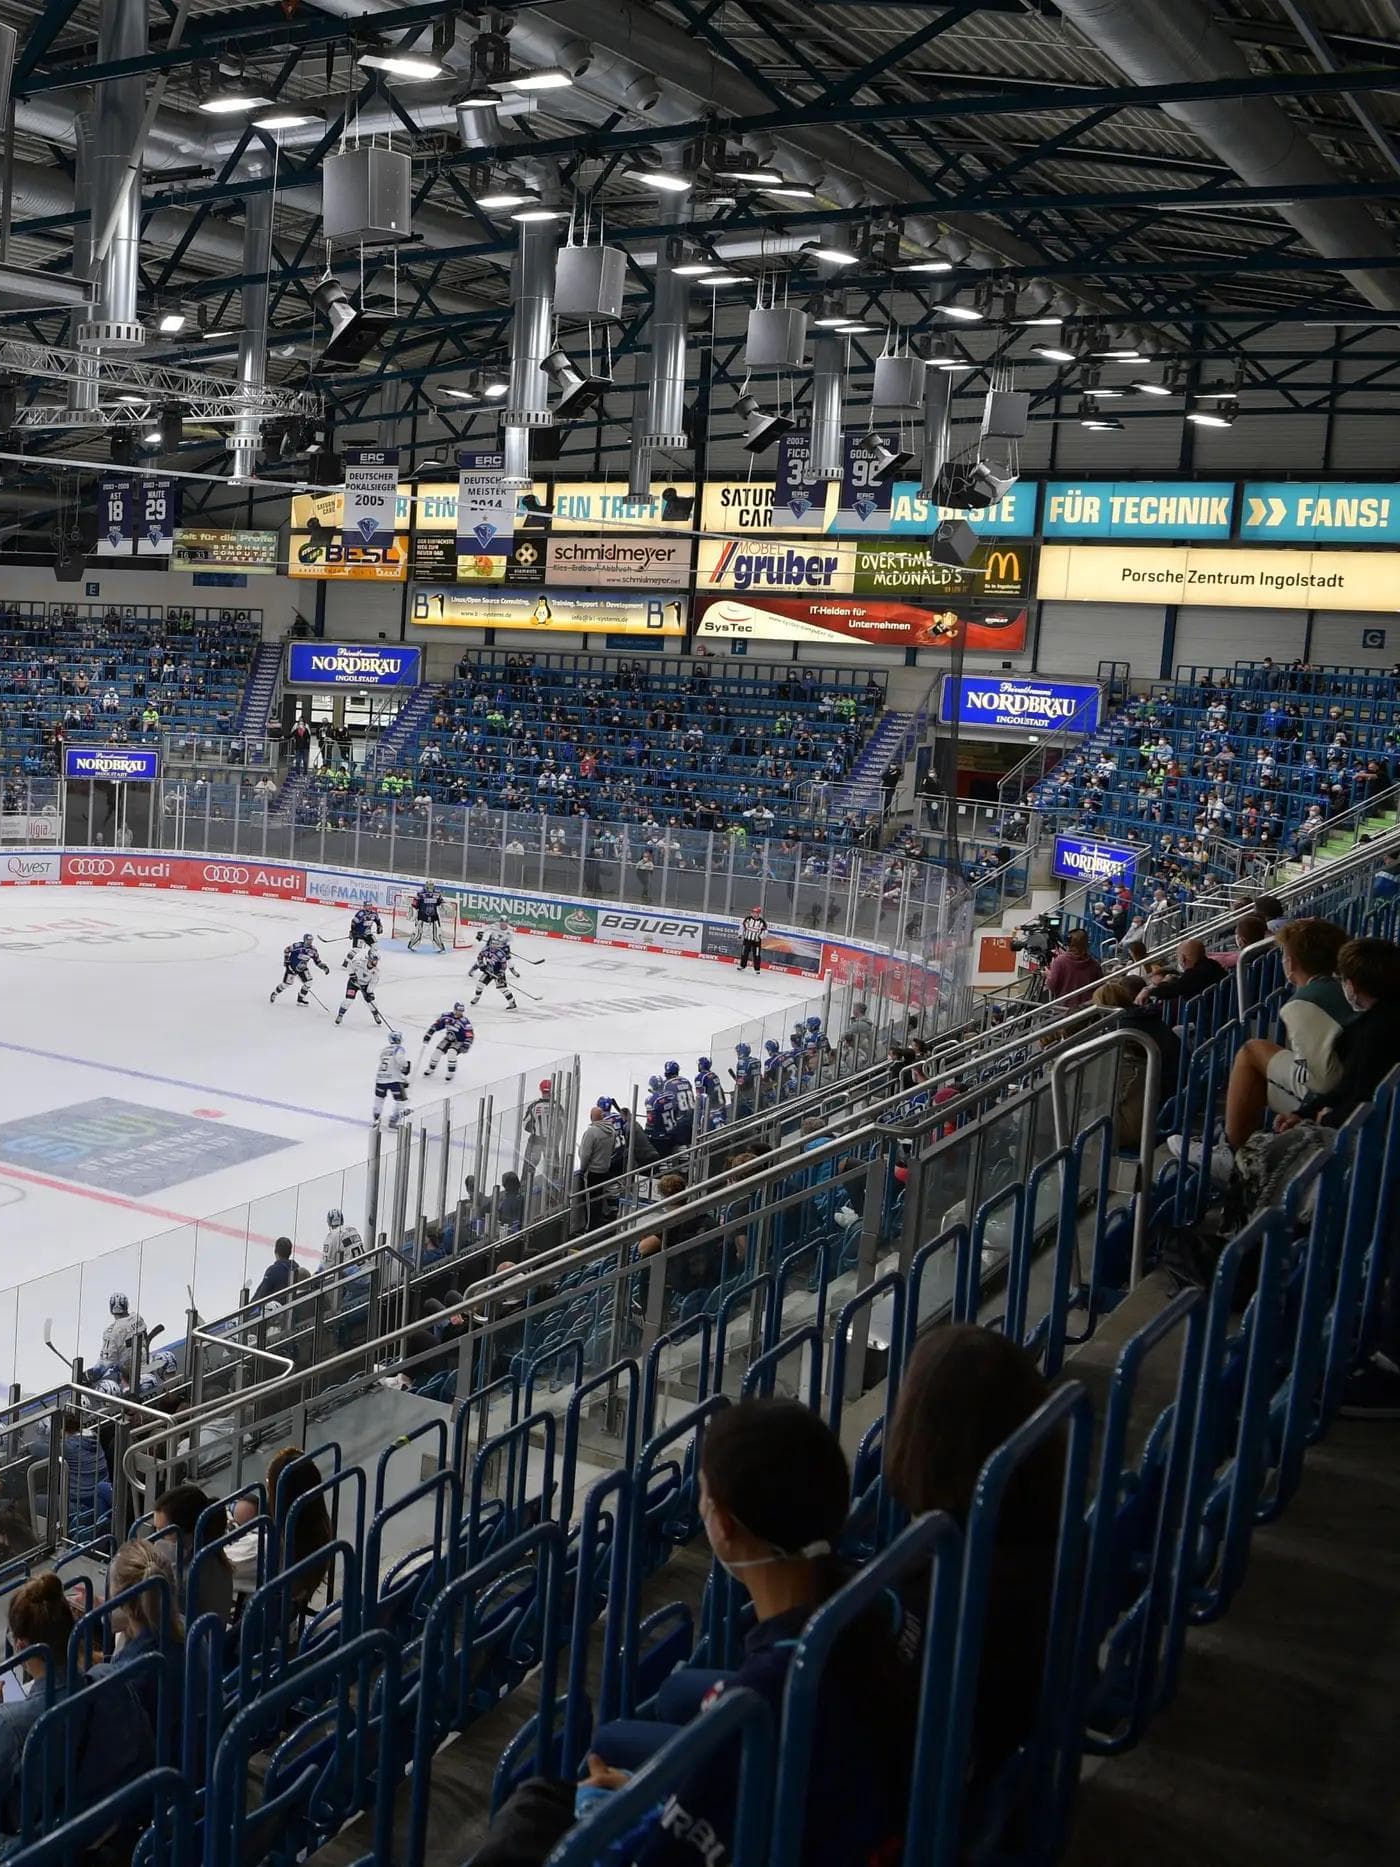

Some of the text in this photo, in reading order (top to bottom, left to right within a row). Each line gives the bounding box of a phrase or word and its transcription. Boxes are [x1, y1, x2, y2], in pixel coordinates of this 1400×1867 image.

[360, 453, 384, 461] ERC
[475, 456, 502, 465] ERC
[349, 472, 393, 481] DEUTSCHER
[346, 483, 397, 491] POKALSIEGER
[468, 487, 507, 496] MEISTER
[110, 492, 122, 500] AST
[355, 494, 385, 506] 2005
[108, 501, 123, 522] 18
[145, 499, 167, 520] 29
[424, 496, 457, 518] EIN
[557, 496, 591, 518] EIN
[1050, 490, 1390, 528] FÜR TECHNIK FANS!
[175, 531, 198, 540] Zeit
[200, 533, 218, 542] für
[220, 533, 237, 541] die
[554, 543, 677, 566] schmidmeyer
[733, 549, 839, 590] gruber
[1122, 568, 1344, 589] Porsche Zentrum Ingolstadt
[481, 597, 500, 605] Source
[551, 600, 644, 610] Training, Support Development
[809, 606, 866, 617] IT-Helden für
[704, 621, 753, 633] SysTec
[848, 619, 911, 631] Unternehmen
[735, 640, 743, 652] F
[1366, 630, 1383, 648] G
[311, 654, 402, 675] NORDBRÄU
[335, 675, 379, 683] INGOLSTADT
[966, 691, 1076, 719] NORDBRÄU
[996, 715, 1049, 728] INGOLSTADT
[76, 757, 147, 772] NORDBRÄU
[120, 862, 170, 878] Audi
[254, 871, 301, 890] Audi
[309, 881, 379, 900] HOFMANN
[456, 892, 562, 920] HERRNBRÄU
